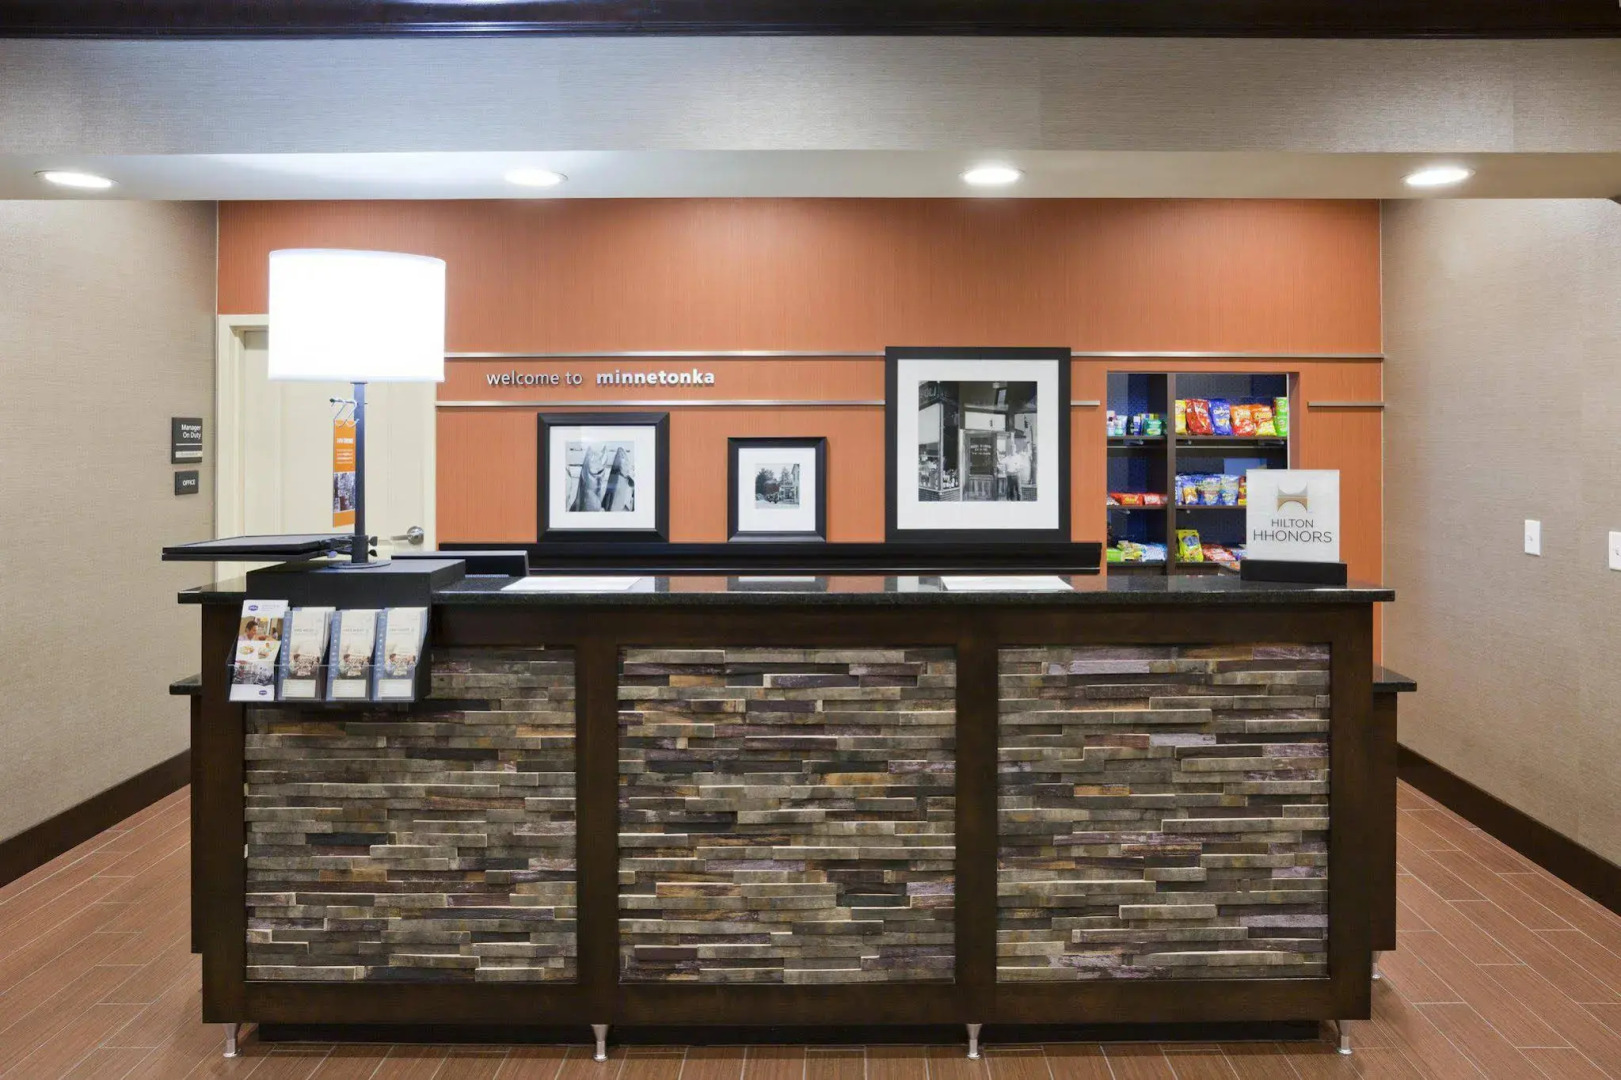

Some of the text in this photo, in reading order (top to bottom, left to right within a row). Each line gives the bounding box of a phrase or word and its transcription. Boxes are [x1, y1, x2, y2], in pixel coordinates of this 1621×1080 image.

[486, 369, 715, 385] welcome to minnetonka
[181, 423, 201, 433] Manager
[190, 431, 201, 440] Duty
[1271, 518, 1314, 529] HILTON
[1253, 530, 1333, 543] HHONORS
